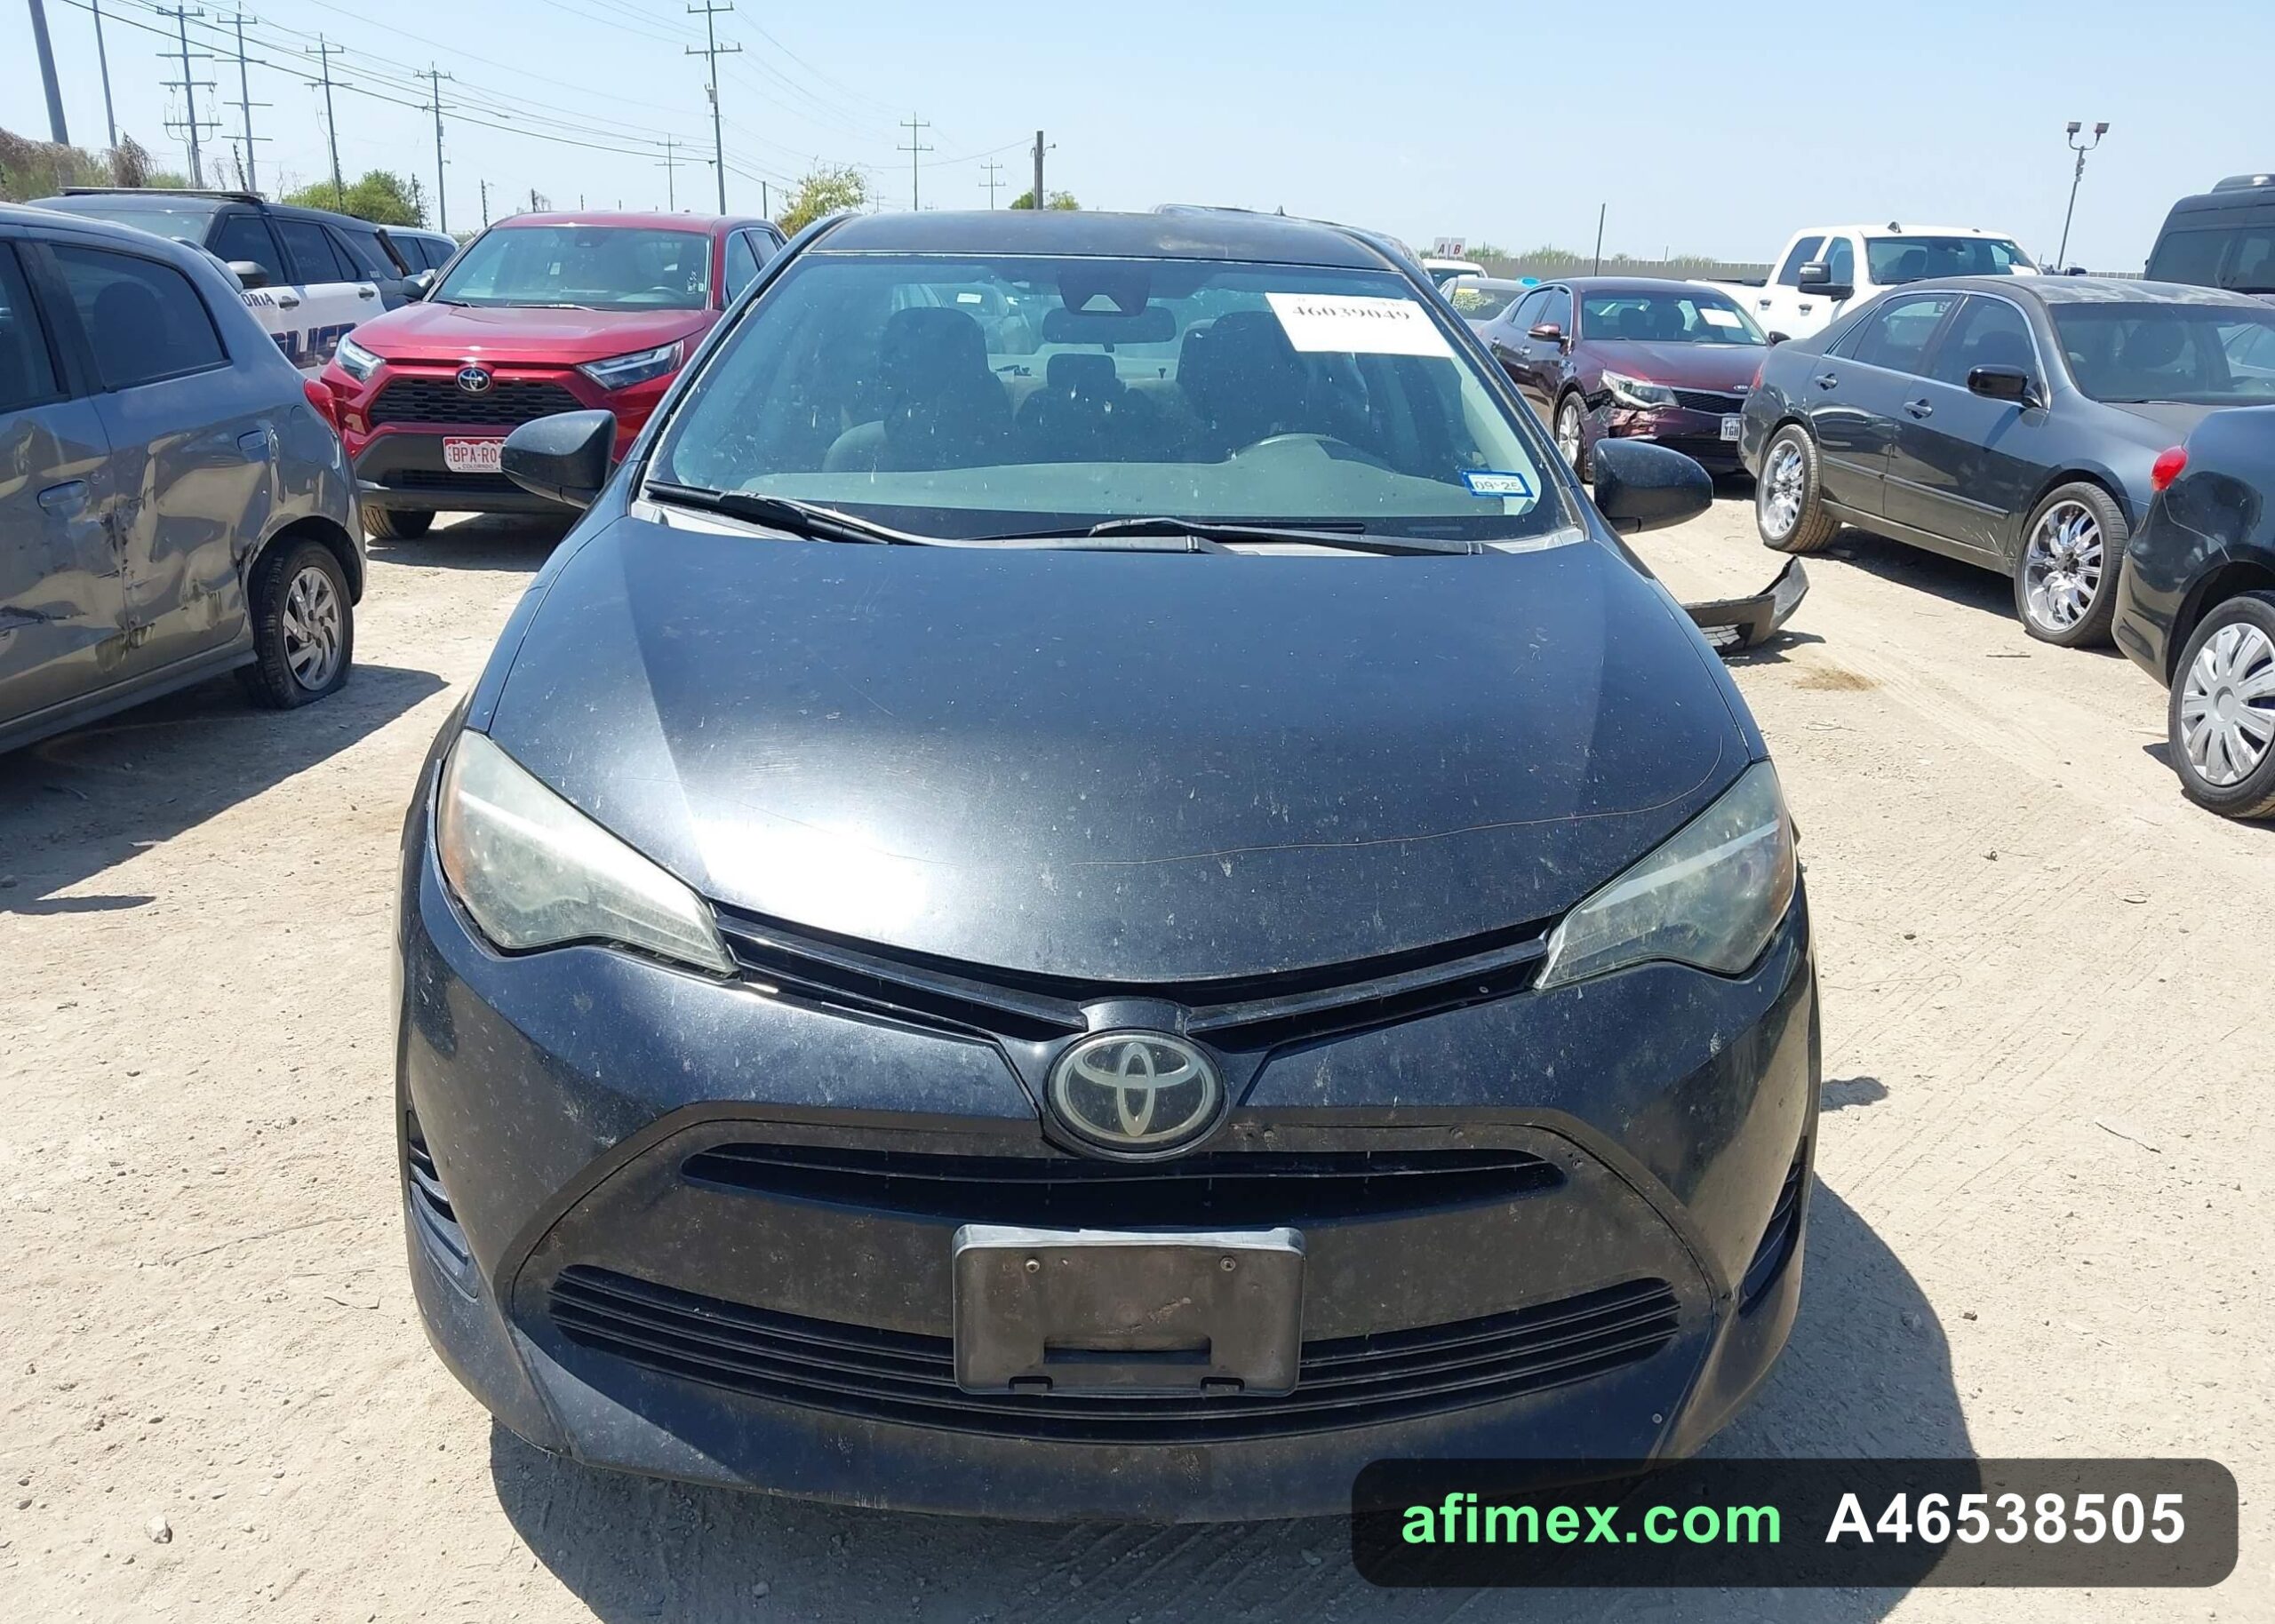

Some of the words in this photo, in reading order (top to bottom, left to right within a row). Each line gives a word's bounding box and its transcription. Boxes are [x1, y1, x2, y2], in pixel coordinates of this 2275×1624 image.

[1438, 243, 1445, 254] A
[1453, 244, 1462, 255] B
[240, 292, 275, 307] ORIA
